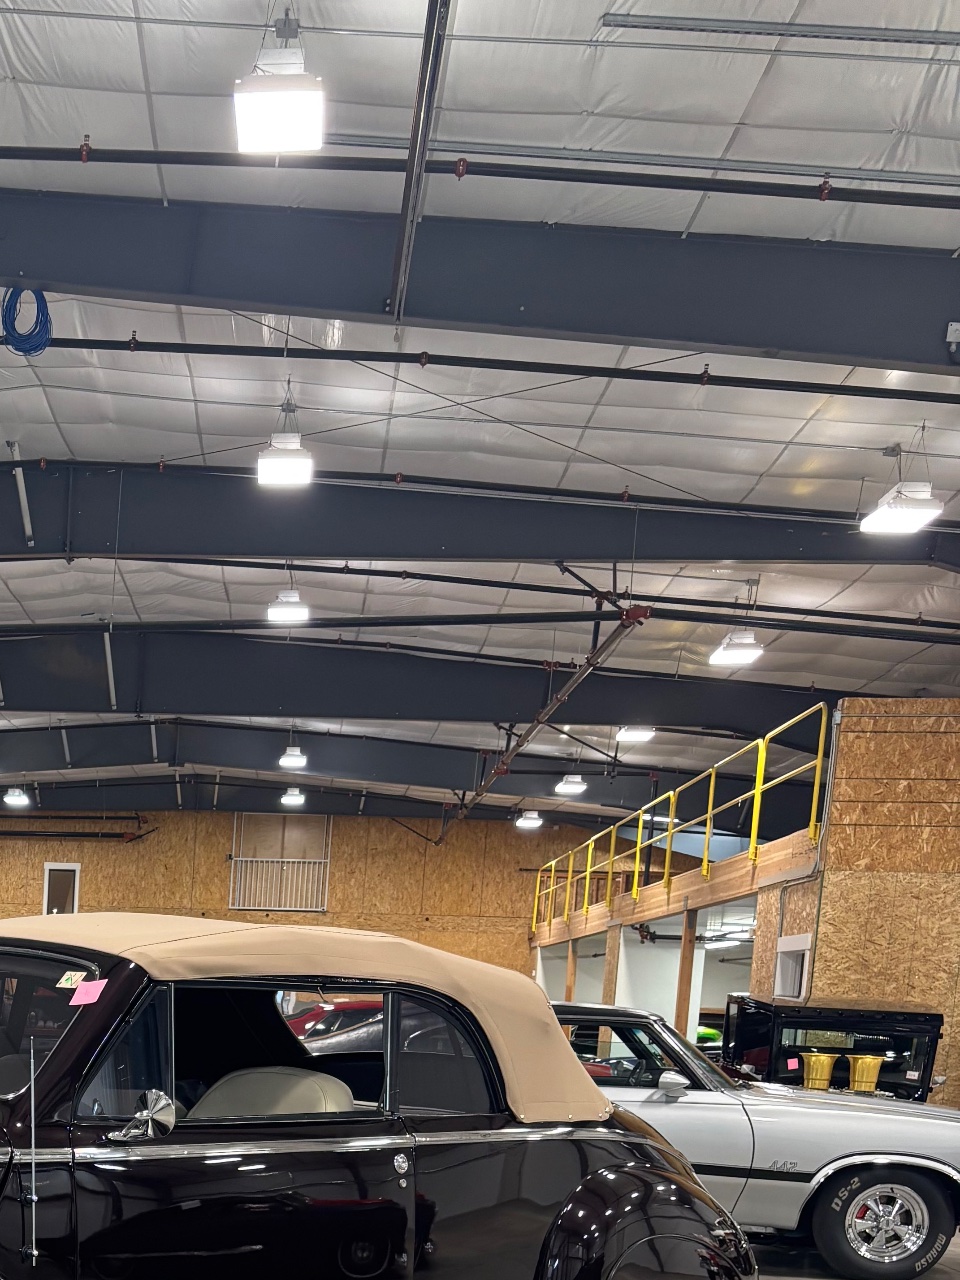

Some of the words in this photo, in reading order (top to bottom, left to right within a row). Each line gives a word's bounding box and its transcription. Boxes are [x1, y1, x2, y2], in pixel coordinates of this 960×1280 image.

[769, 1160, 798, 1173] 442
[831, 1177, 861, 1212] DS-2
[914, 1233, 947, 1272] MOROSO
